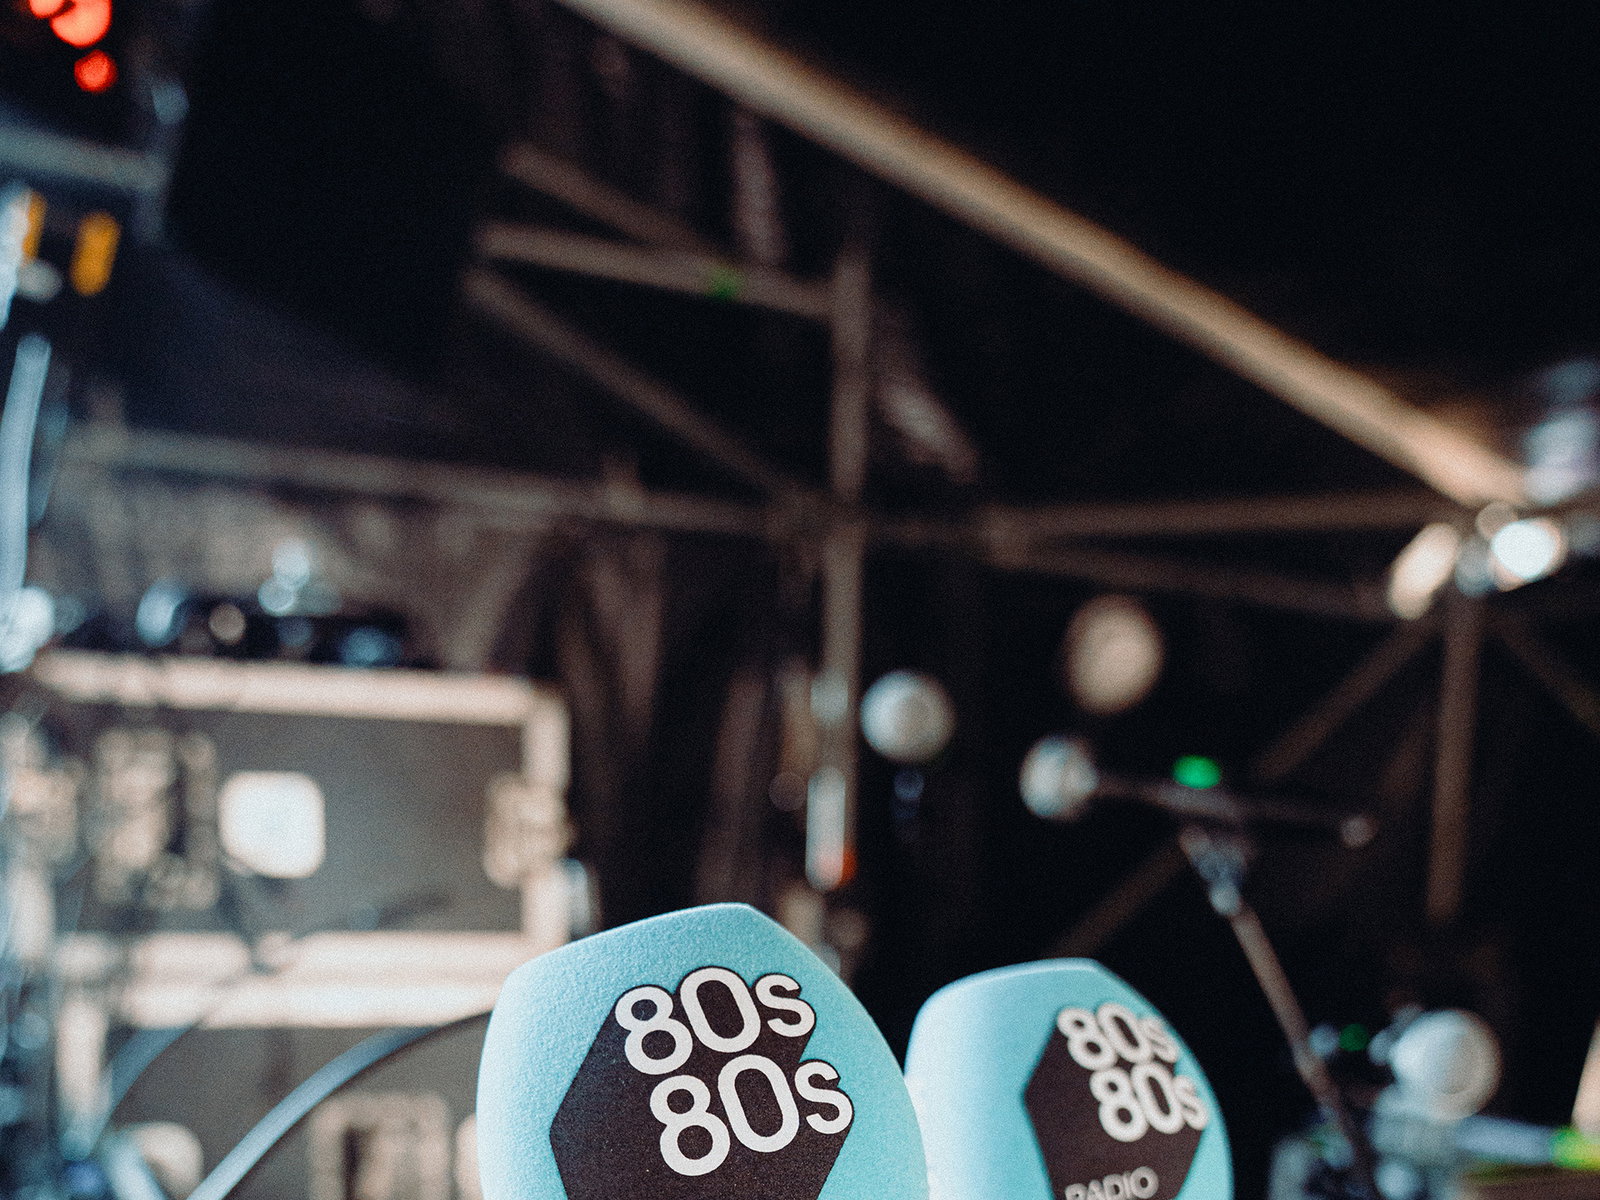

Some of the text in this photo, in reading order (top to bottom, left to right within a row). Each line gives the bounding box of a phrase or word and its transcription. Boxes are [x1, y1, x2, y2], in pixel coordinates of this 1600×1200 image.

[614, 965, 816, 1075] 80s
[1057, 1001, 1179, 1071] 80s
[650, 1053, 855, 1177] 80s
[1090, 1061, 1208, 1142] 80s
